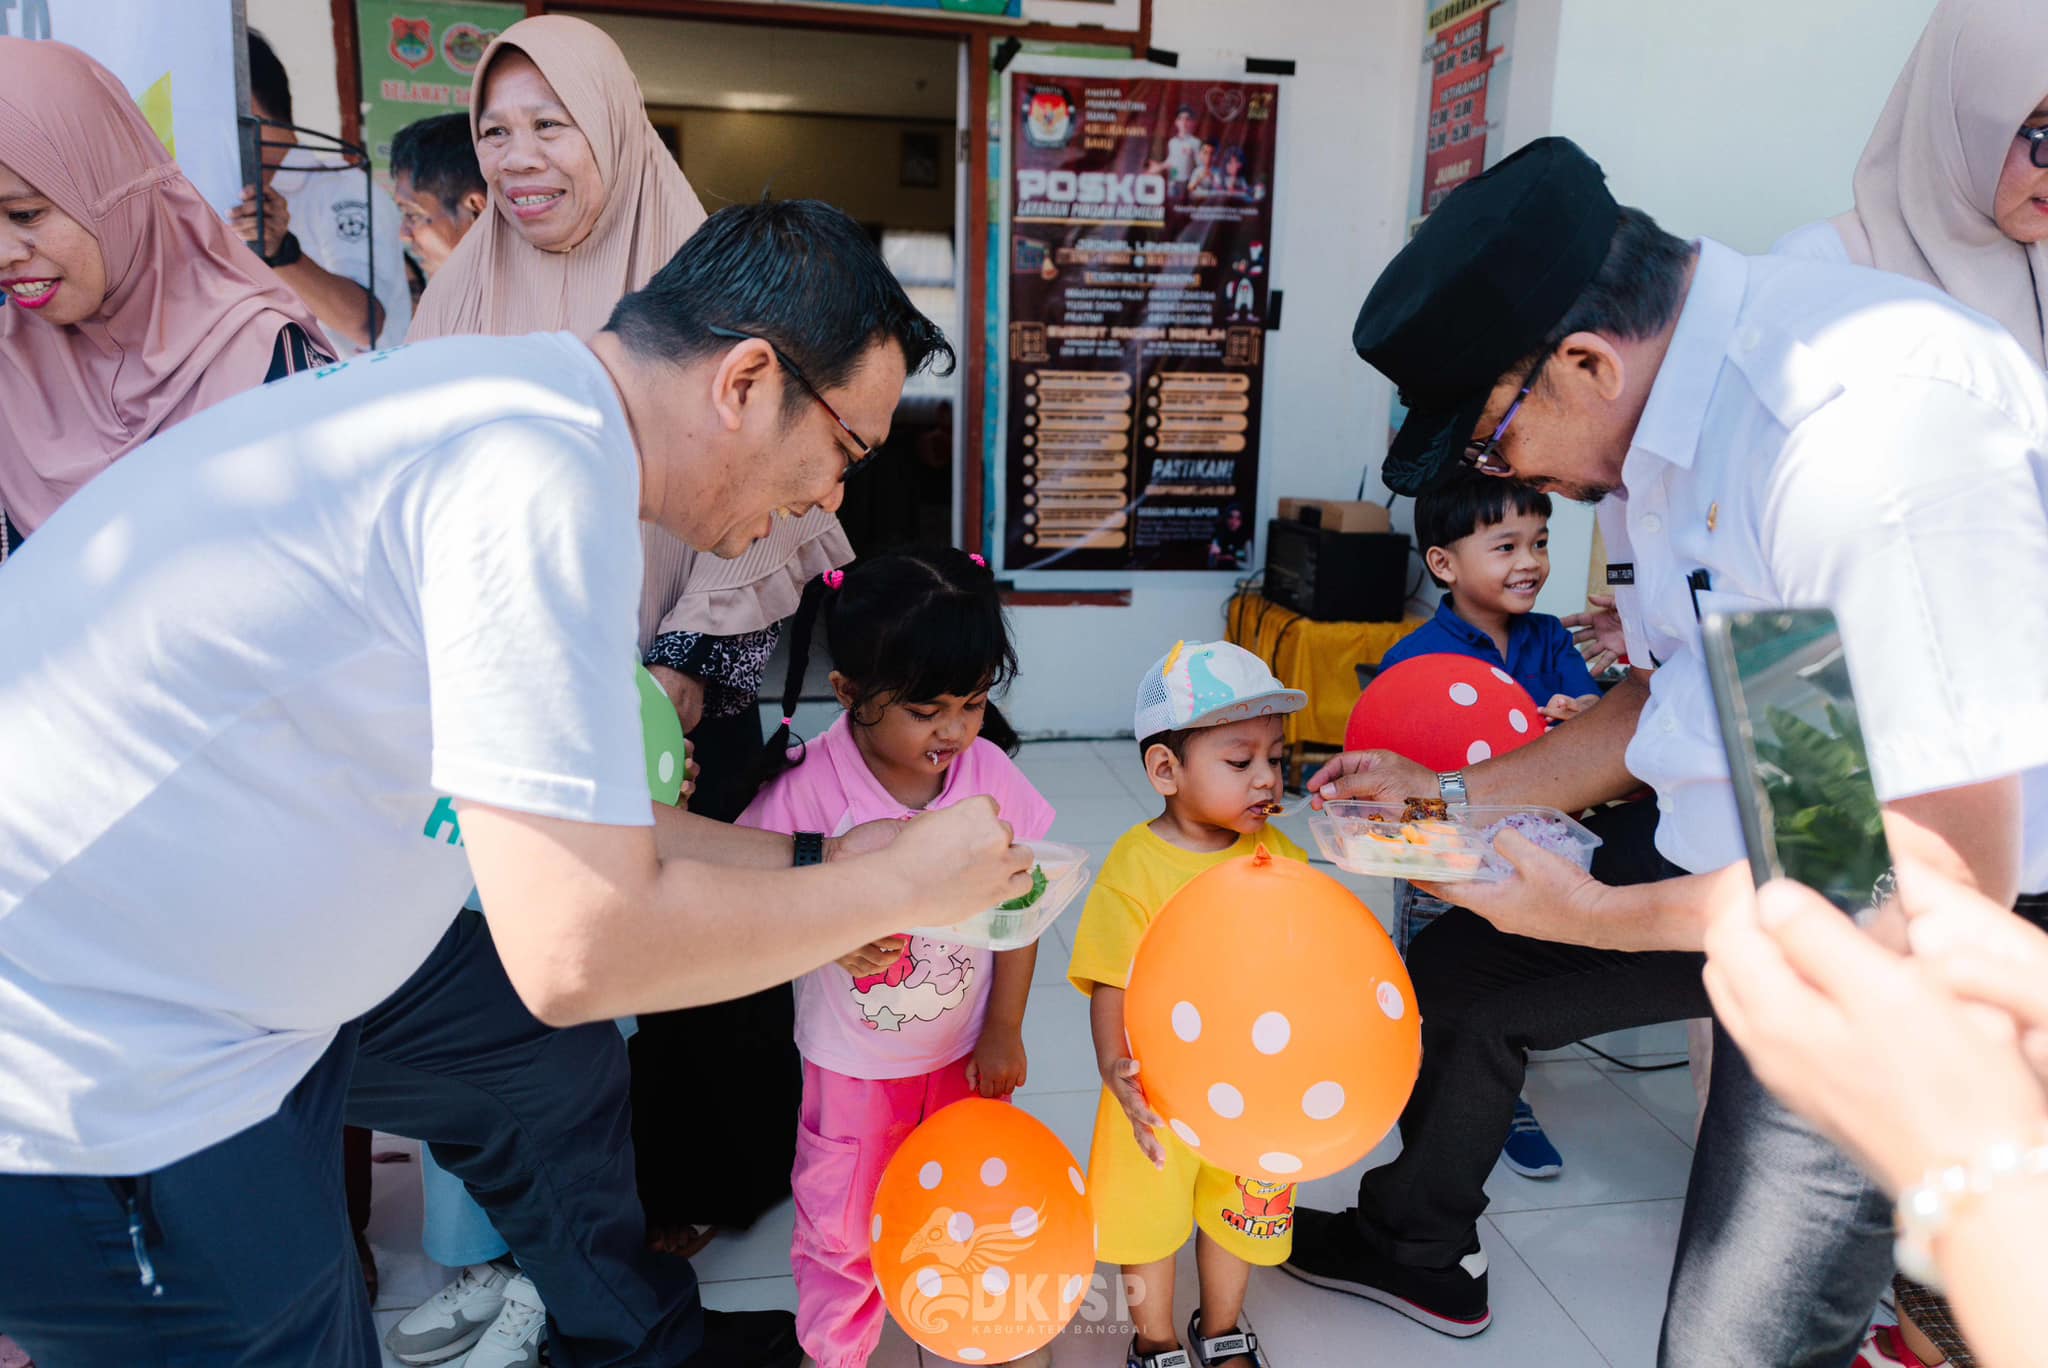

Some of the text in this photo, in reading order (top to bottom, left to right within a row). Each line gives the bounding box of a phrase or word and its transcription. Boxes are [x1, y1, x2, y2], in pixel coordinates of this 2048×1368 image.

[381, 80, 450, 105] SELAMAT
[1434, 159, 1473, 186] JUMAT
[1017, 169, 1166, 206] POSKO
